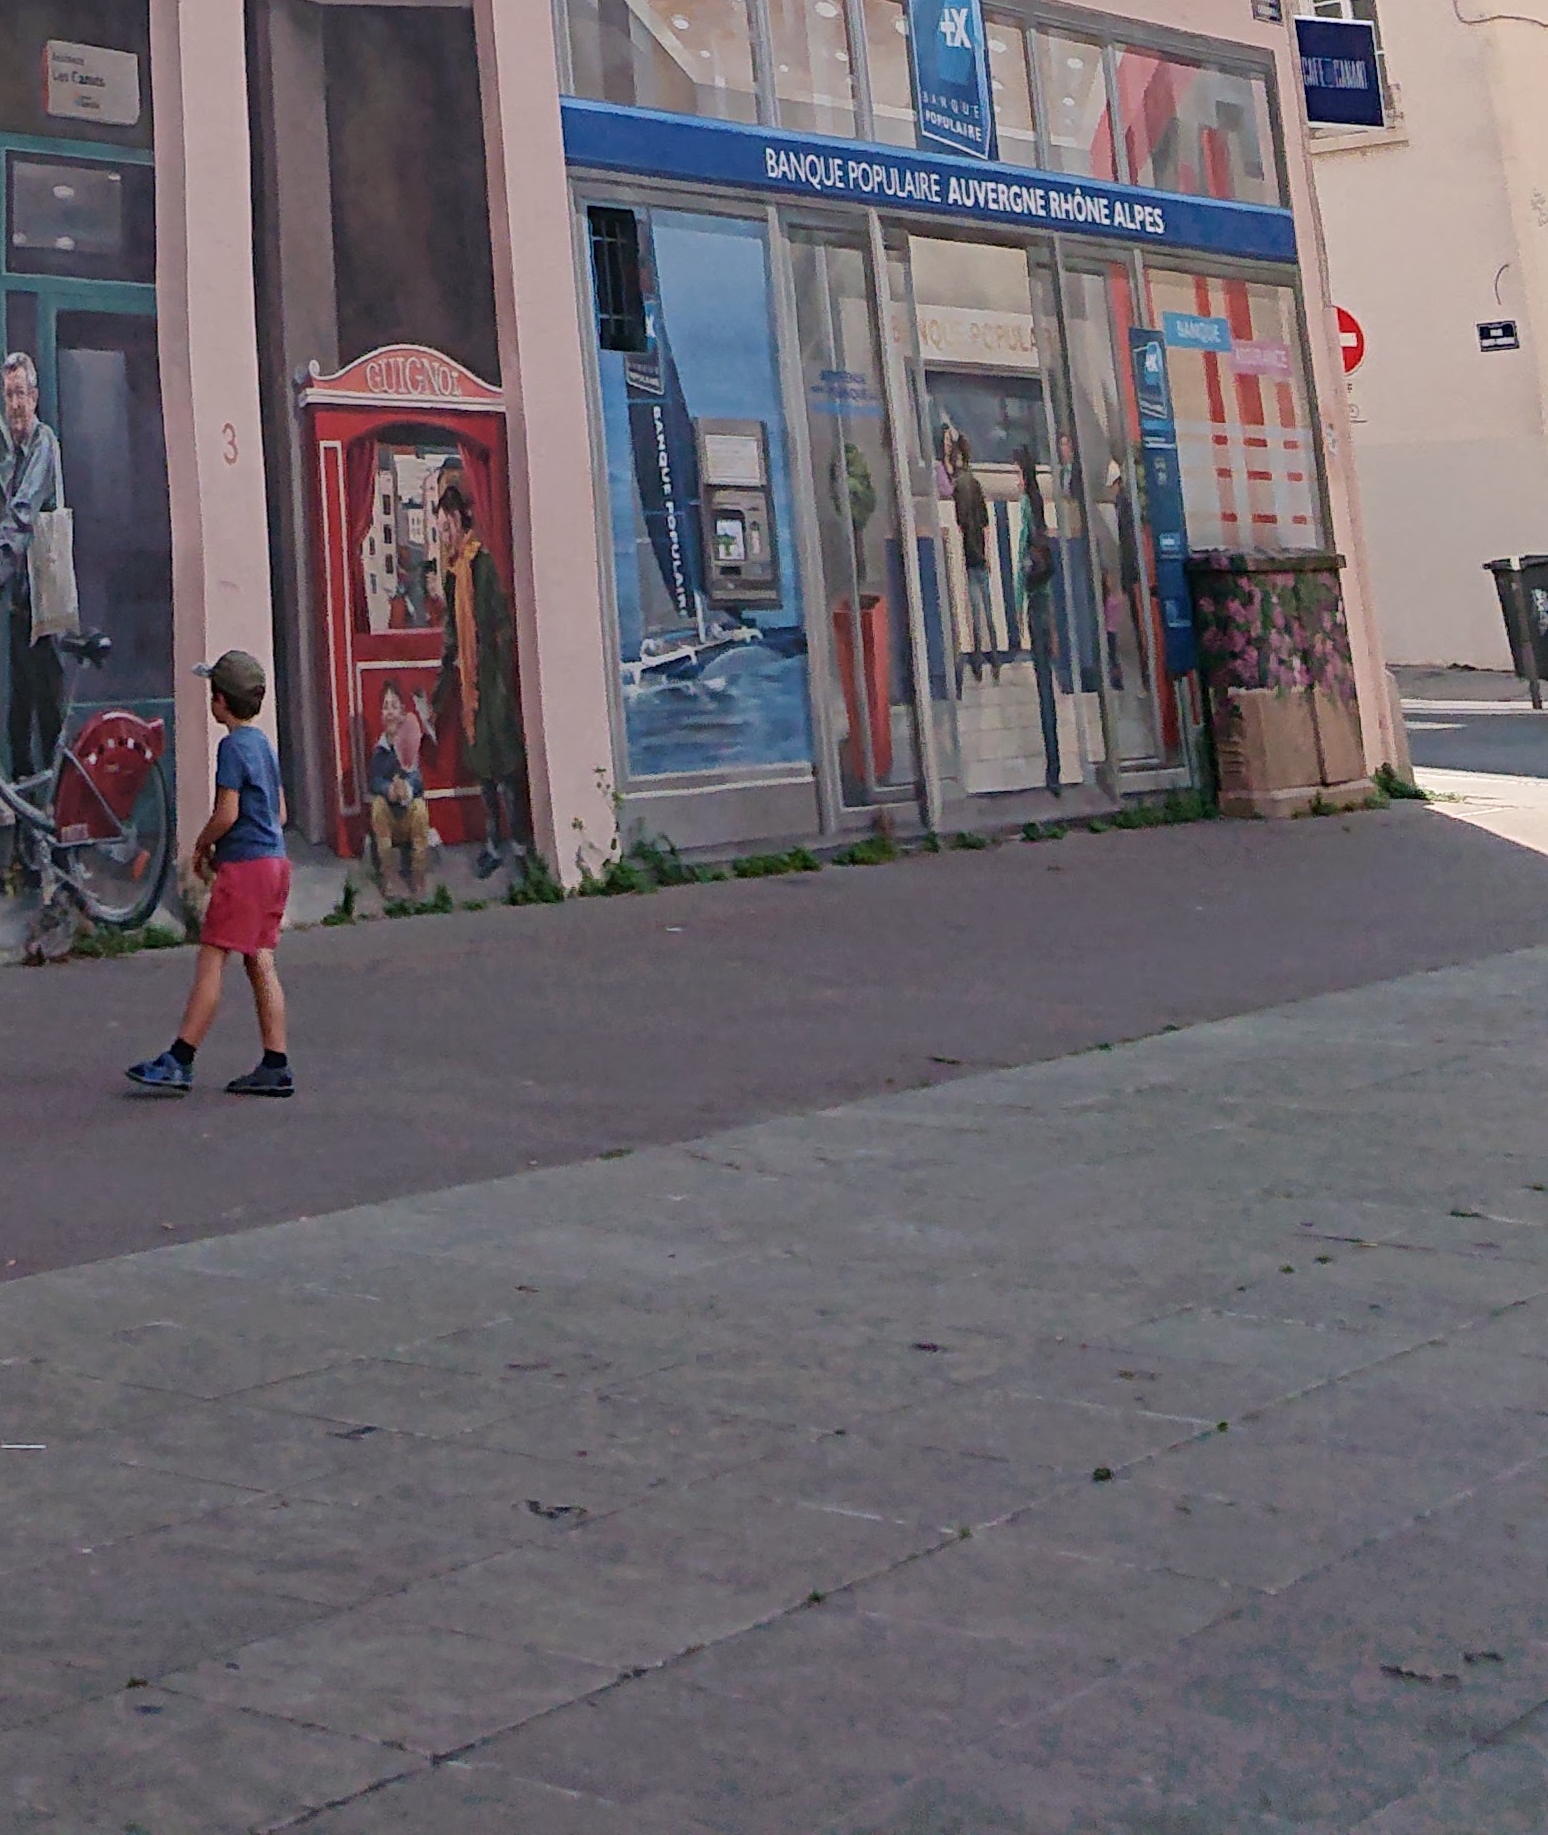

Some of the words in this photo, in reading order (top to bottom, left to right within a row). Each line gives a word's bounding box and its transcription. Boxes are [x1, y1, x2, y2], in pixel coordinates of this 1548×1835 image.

[923, 91, 980, 119] BANQUE
[925, 110, 983, 143] POPULAIRE
[765, 147, 846, 190] BANQUE
[848, 160, 942, 203] POPULAIRE
[947, 176, 1047, 217] AUVERGNE
[1048, 187, 1111, 226] RHÔNE
[1113, 200, 1166, 235] ALPES
[221, 422, 239, 466] 3
